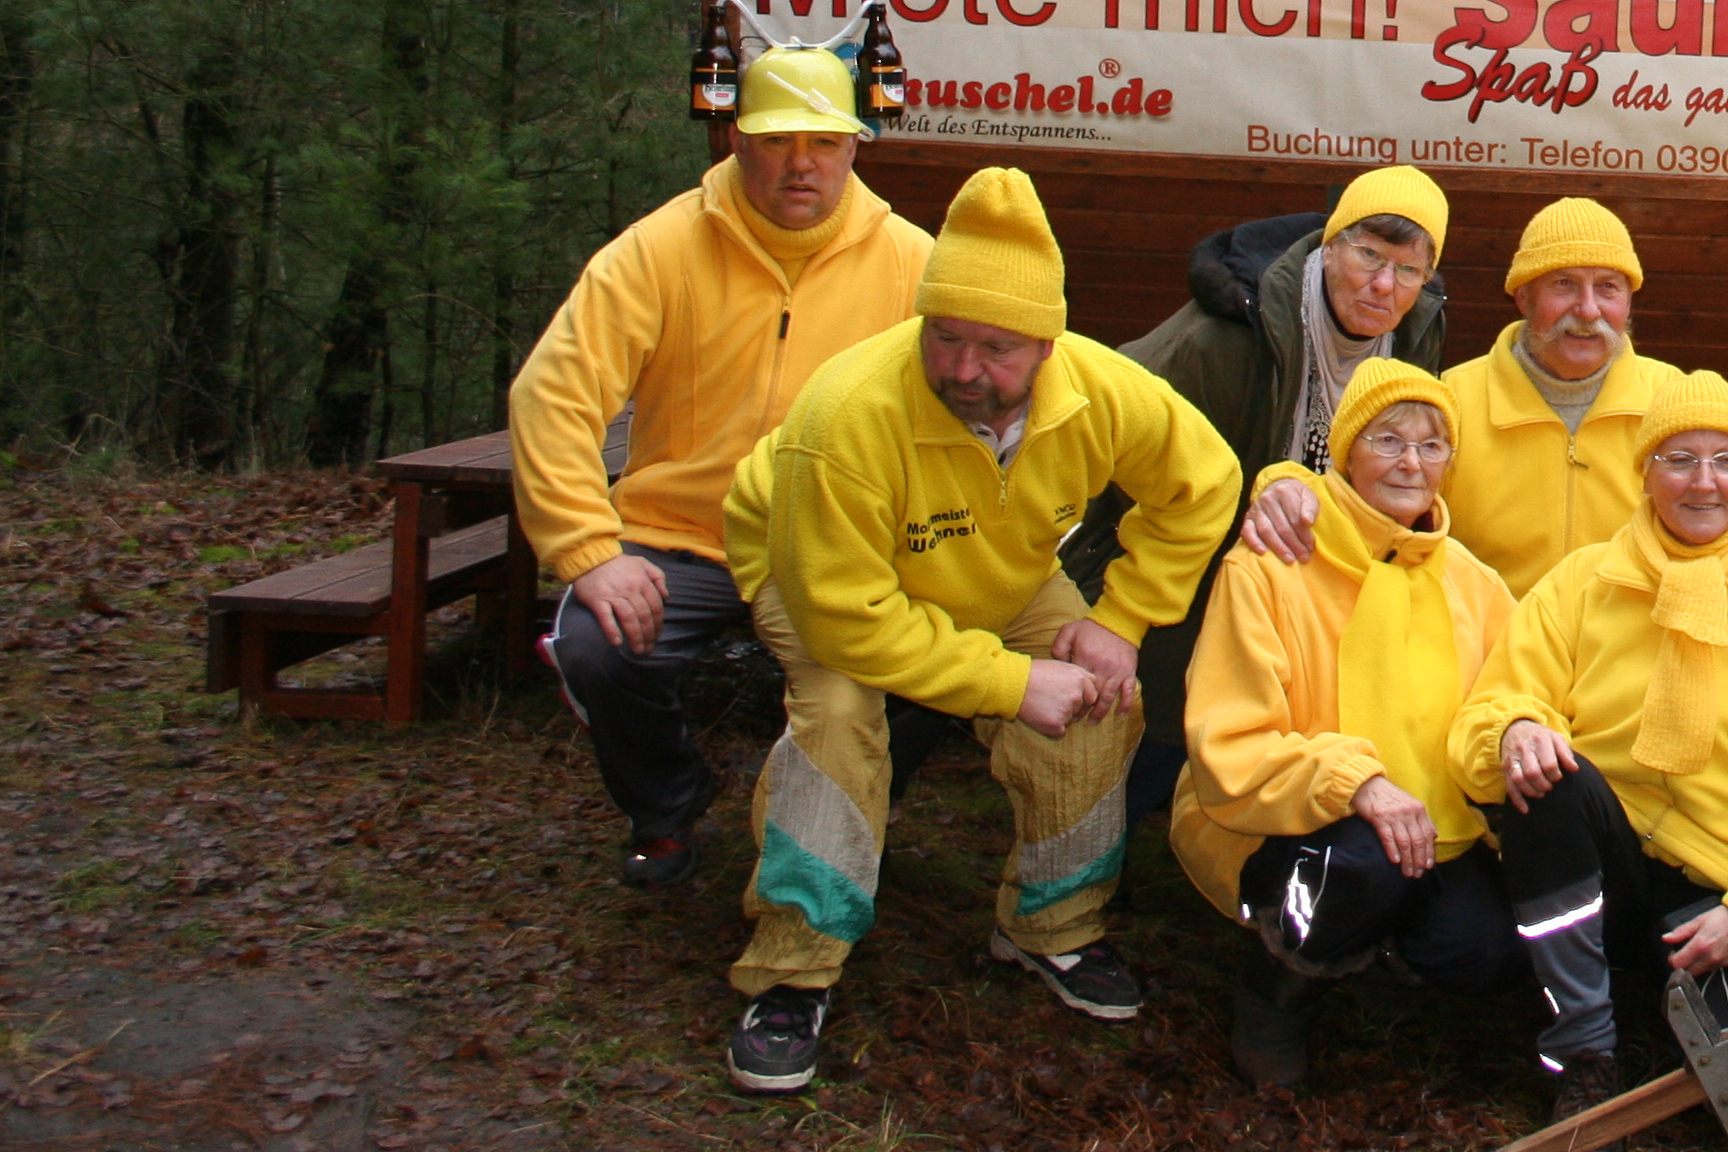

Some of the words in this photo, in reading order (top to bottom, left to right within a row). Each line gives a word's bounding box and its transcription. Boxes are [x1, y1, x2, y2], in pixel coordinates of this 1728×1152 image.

[1420, 22, 1605, 124] Spaß
[1611, 69, 1672, 113] das
[885, 113, 931, 134] Welt
[937, 114, 968, 136] des
[1246, 124, 1398, 165] Buchung
[1411, 136, 1506, 164] unter:
[1520, 138, 1644, 171] Telefon
